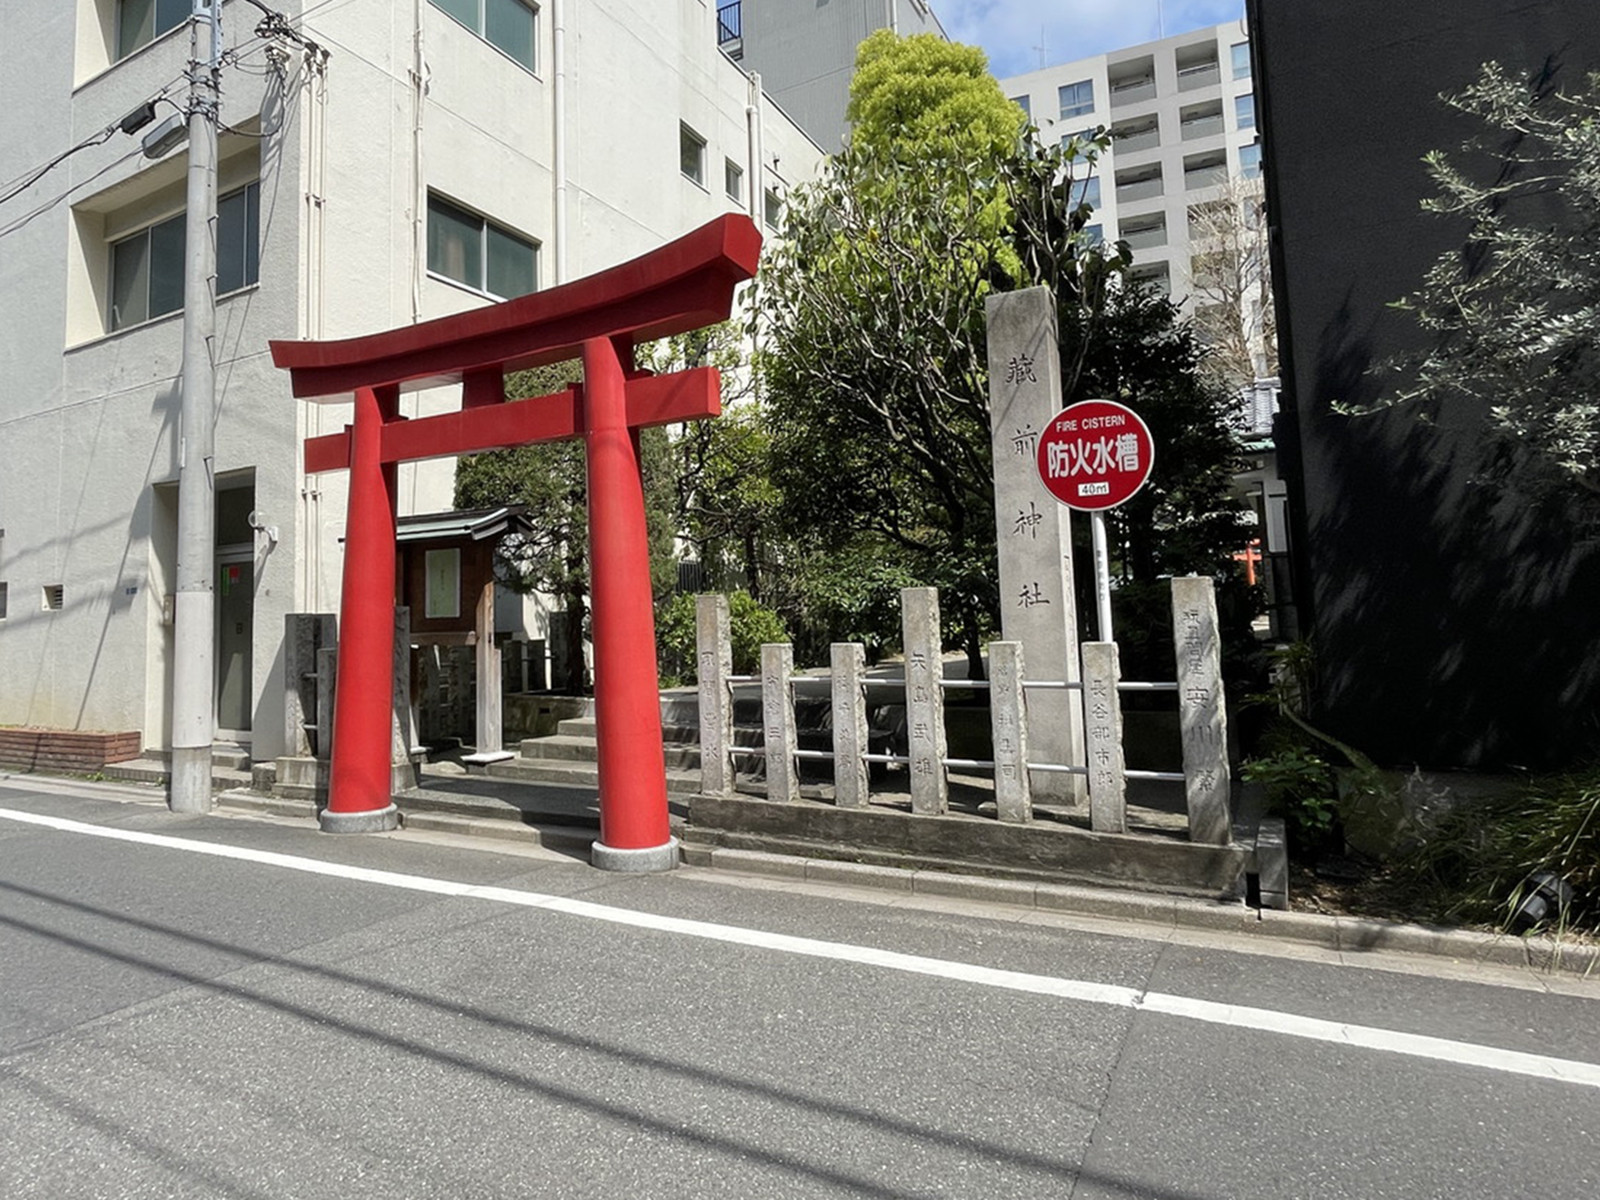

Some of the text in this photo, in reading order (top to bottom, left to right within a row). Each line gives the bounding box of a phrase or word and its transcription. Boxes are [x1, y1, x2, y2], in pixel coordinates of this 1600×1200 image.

[1056, 414, 1126, 433] FIRE CISTERN
[1047, 433, 1139, 478] 防火水槽
